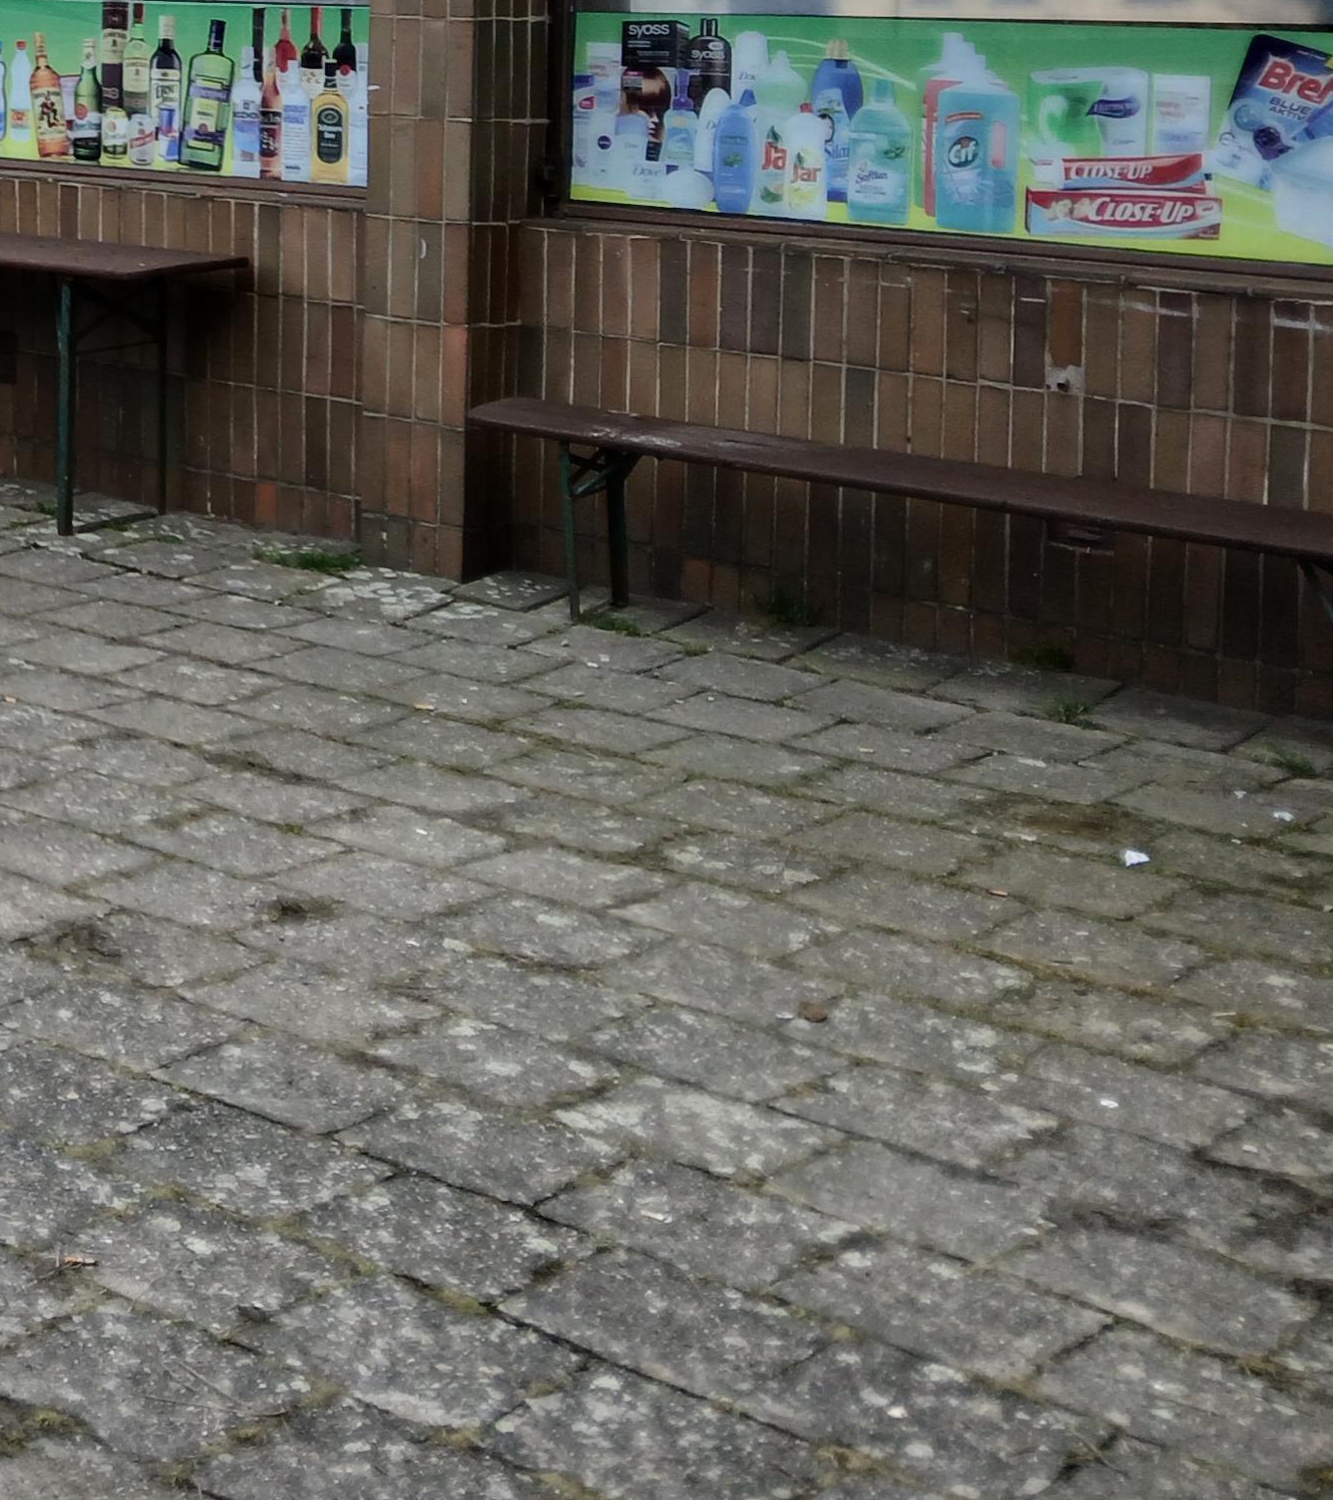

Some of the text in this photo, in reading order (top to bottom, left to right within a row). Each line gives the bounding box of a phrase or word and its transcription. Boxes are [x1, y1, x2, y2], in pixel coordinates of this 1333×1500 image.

[628, 24, 670, 40] syoss
[691, 49, 725, 61] syoss
[1269, 96, 1312, 116] BLUE
[1269, 106, 1306, 121] AKTIV
[761, 141, 787, 171] Ja
[949, 143, 976, 162] Cif
[790, 163, 822, 184] Jar
